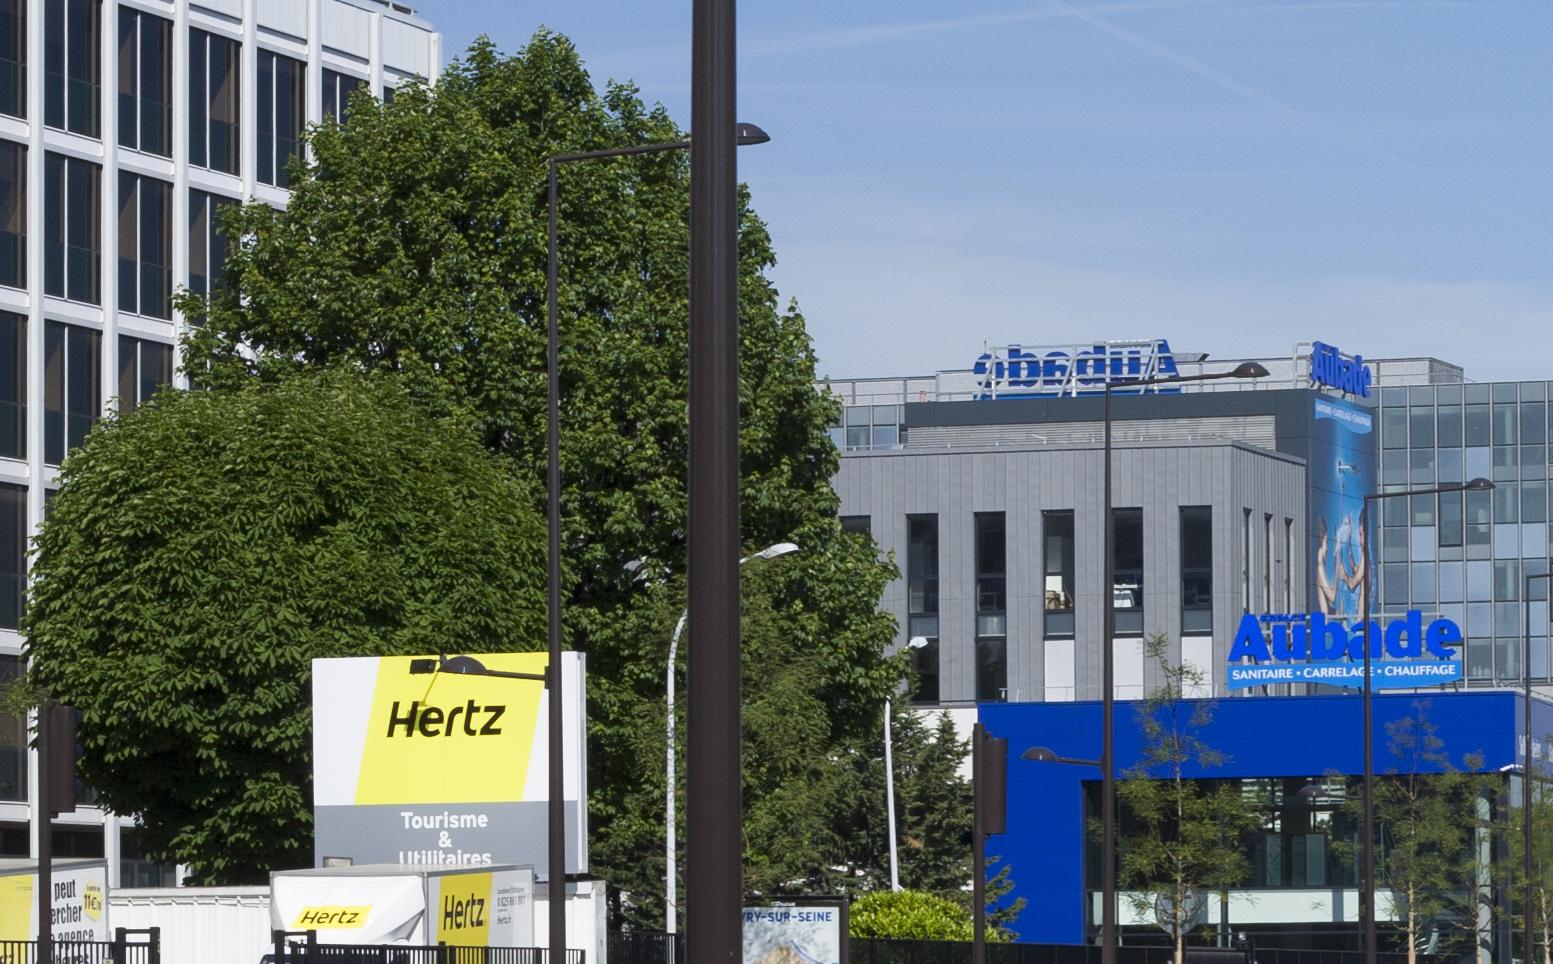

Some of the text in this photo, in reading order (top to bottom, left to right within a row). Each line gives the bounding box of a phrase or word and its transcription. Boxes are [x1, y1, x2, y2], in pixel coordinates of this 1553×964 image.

[1232, 664, 1456, 680] SANITAIRE CARRELAGE CHAUFFAGE
[386, 699, 506, 738] Hertz
[401, 811, 489, 830] Tourisme
[438, 830, 453, 848] &
[54, 879, 76, 900] peut
[51, 904, 82, 925] ercher
[300, 911, 358, 925] Hertz
[443, 893, 485, 931] Hertz
[742, 911, 832, 922] RY-SUR-SEINE
